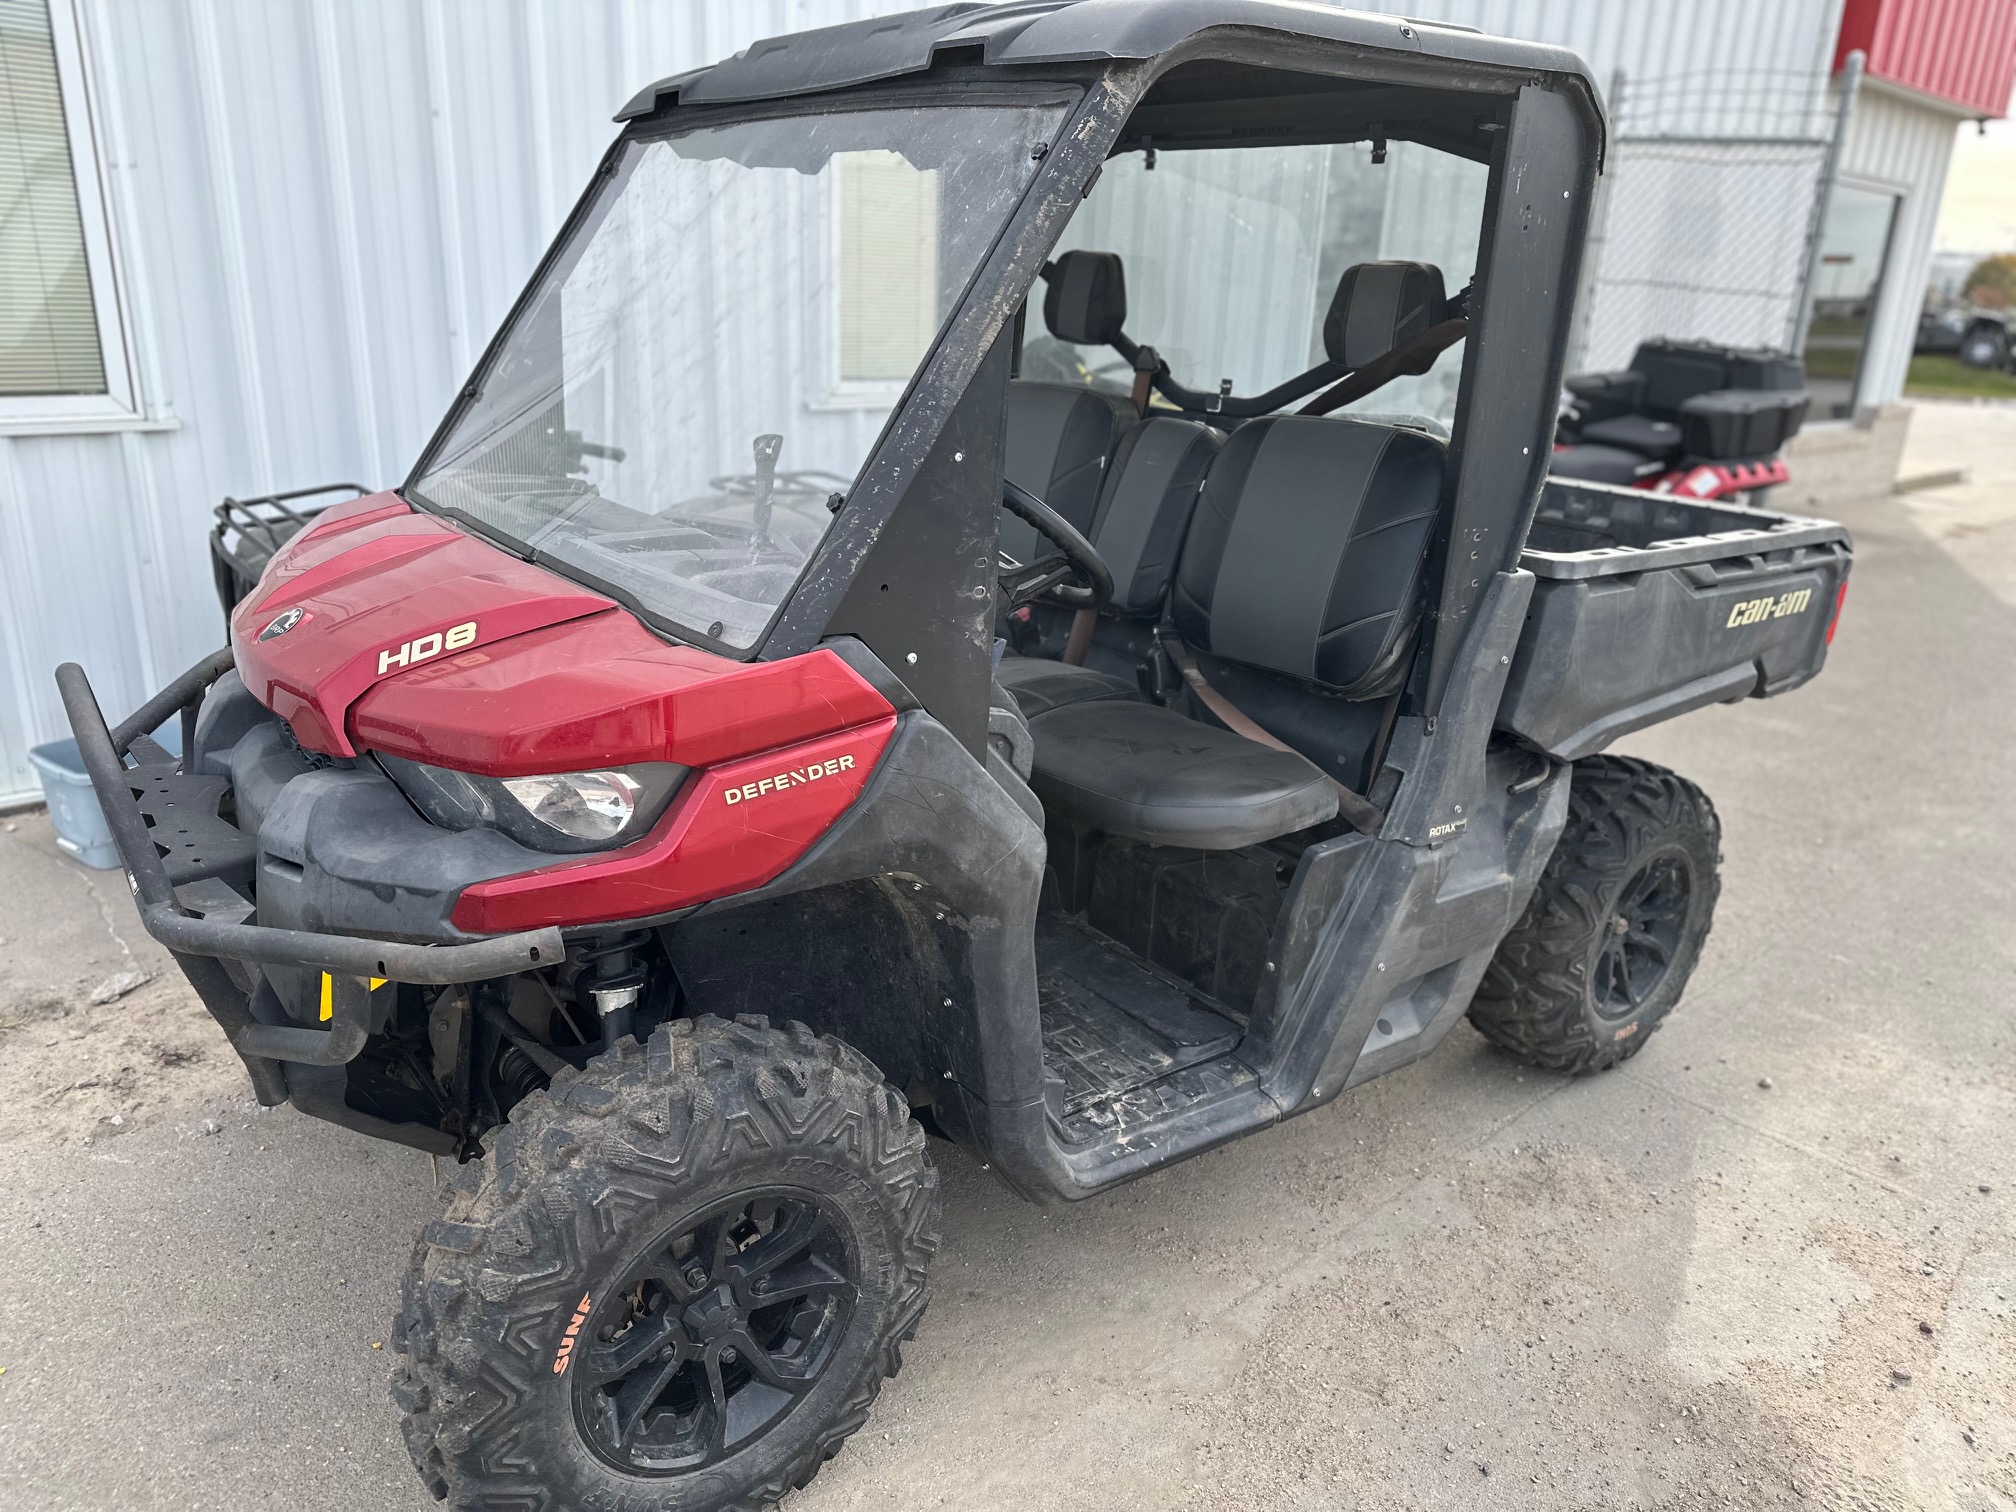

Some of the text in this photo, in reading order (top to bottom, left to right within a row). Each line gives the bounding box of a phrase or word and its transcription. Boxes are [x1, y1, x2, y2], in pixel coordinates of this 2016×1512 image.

[270, 623, 285, 634] BRP
[1726, 587, 1812, 629] can-am
[377, 621, 478, 675] HD8
[724, 754, 856, 805] DEFENDER
[1429, 822, 1456, 838] ROTAX
